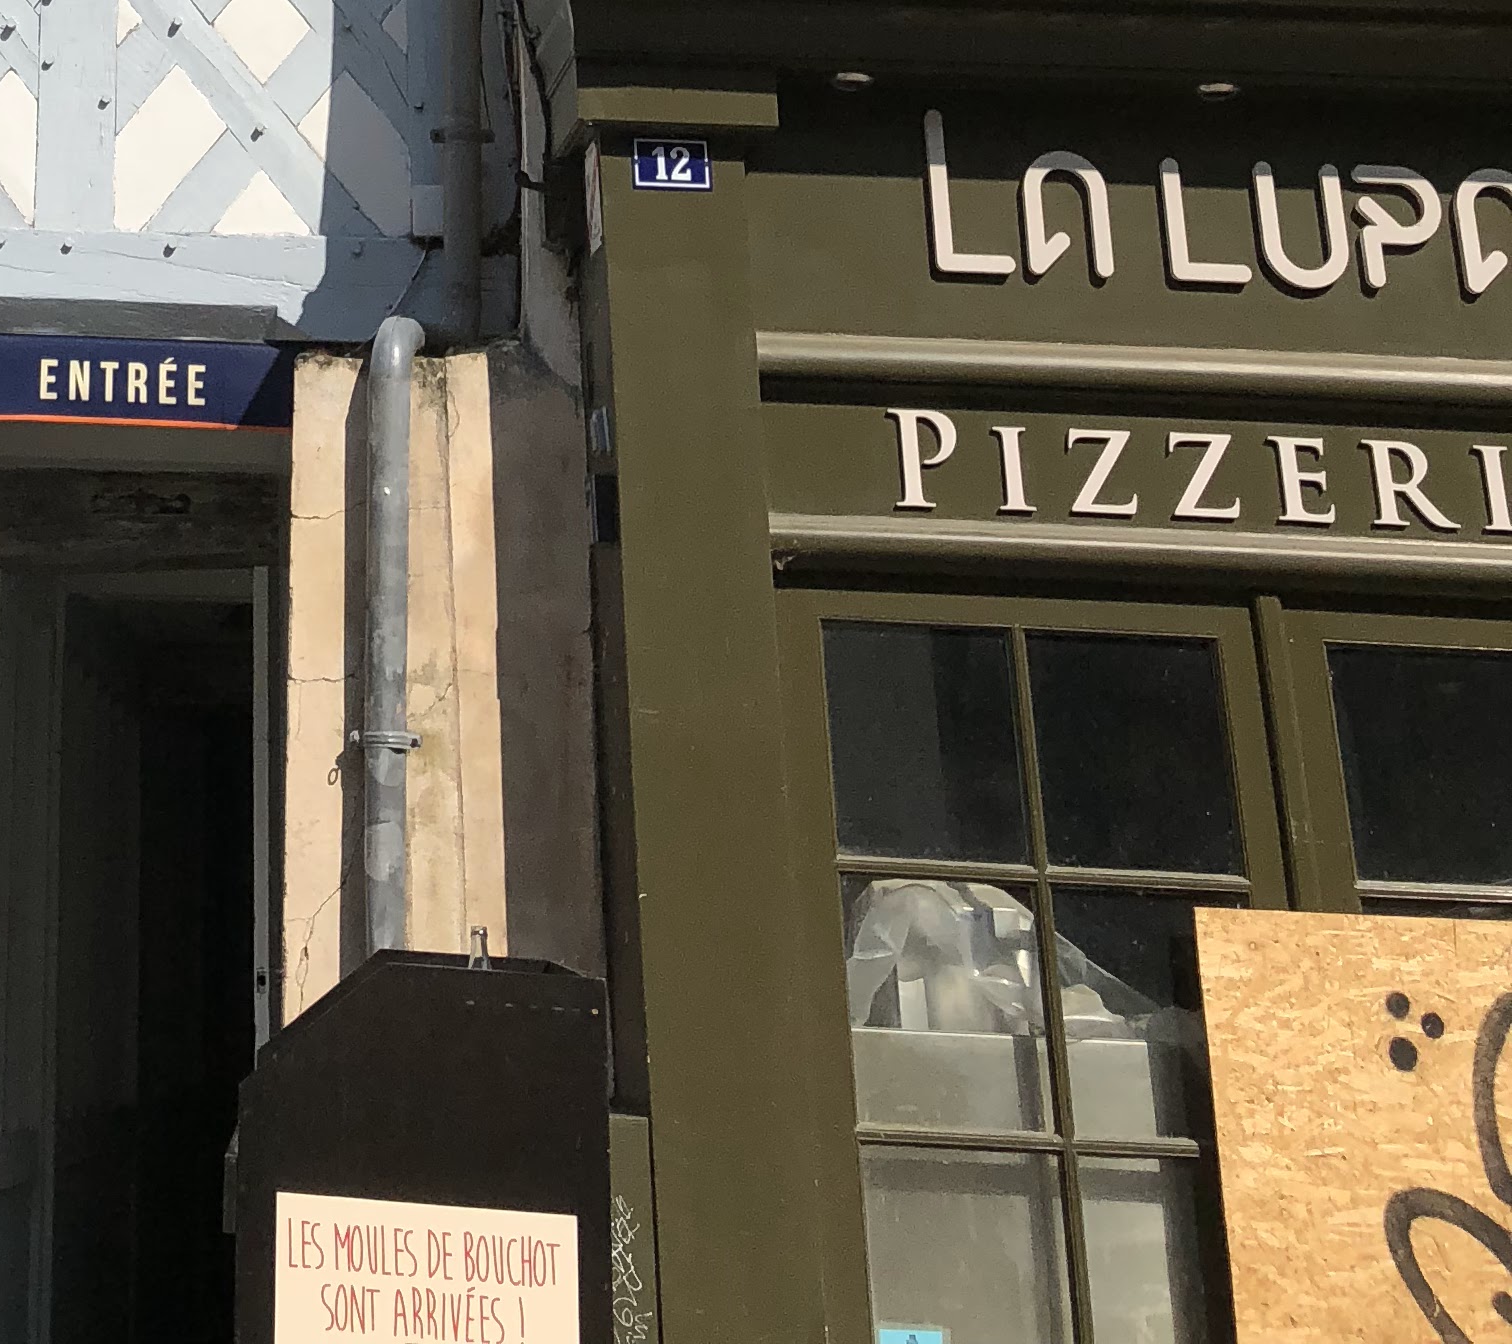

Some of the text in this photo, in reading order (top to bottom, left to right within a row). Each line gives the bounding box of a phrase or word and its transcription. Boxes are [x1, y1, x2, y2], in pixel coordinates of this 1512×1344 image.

[651, 146, 692, 181] 12
[39, 357, 207, 406] ENTRÉE
[886, 407, 1512, 532] PIZZERI
[288, 1217, 561, 1288] LES MOULES DE BOUCHOT
[320, 1283, 526, 1344] SONT ARRIVÉES !
